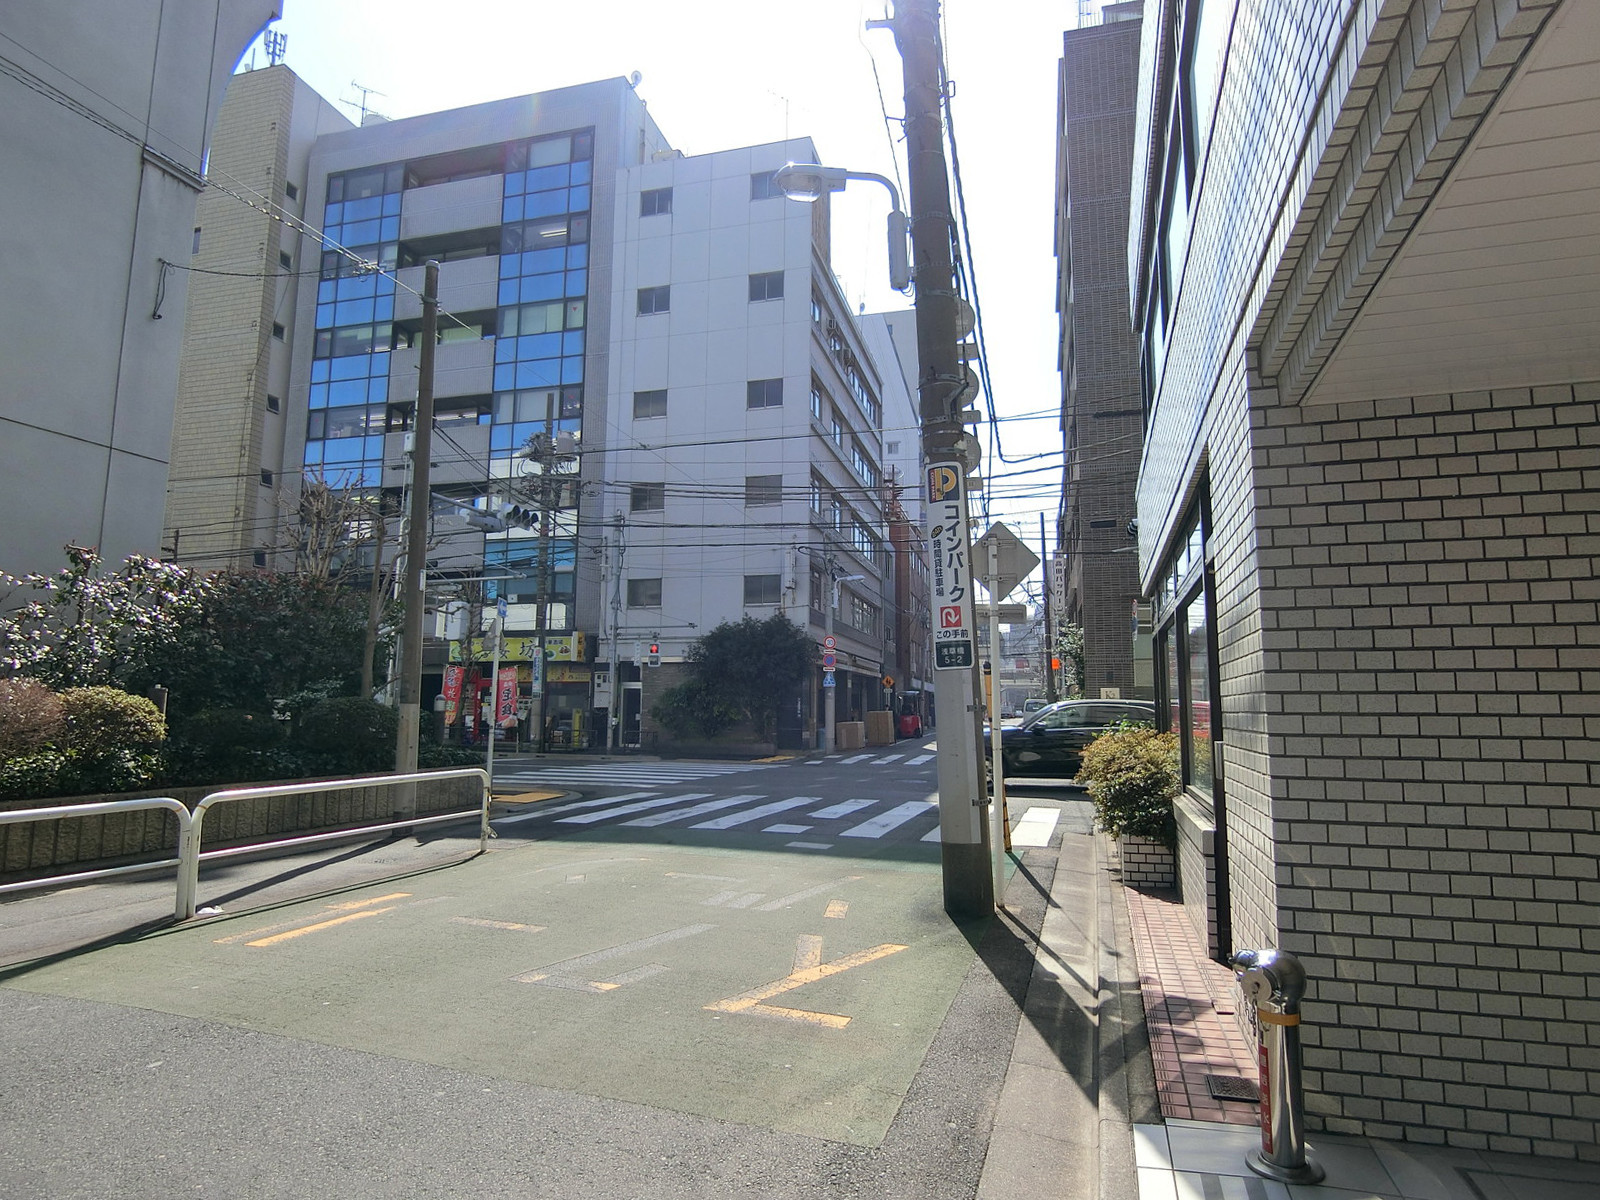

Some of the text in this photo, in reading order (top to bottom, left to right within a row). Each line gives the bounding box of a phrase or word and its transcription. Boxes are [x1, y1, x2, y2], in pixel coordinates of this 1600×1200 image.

[945, 505, 964, 602] コインパーク
[933, 538, 944, 597] 時間貸駐車場
[936, 629, 969, 639] この手前
[941, 646, 965, 656] 浅草橋
[944, 655, 963, 664] 5-2
